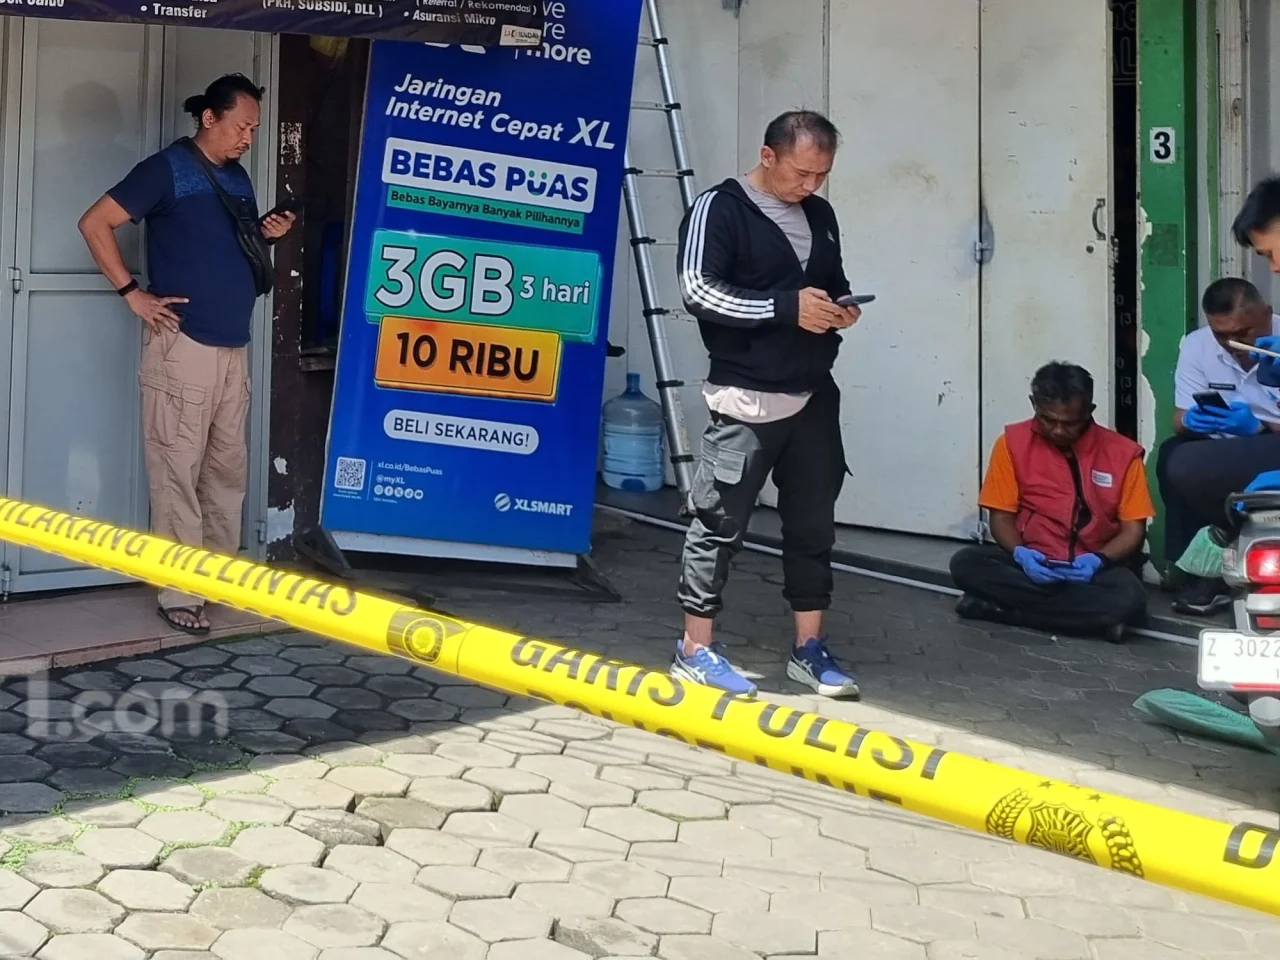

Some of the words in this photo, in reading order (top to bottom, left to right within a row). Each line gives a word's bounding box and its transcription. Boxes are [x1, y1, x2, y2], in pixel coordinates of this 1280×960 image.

[152, 3, 208, 19] Transfer
[412, 9, 461, 24] Asuransi
[464, 13, 496, 26] Mikro
[395, 74, 502, 107] Jaringan
[385, 96, 484, 130] Internet
[491, 113, 564, 141] Cepat
[569, 117, 615, 149] XL
[1153, 130, 1172, 160] 3
[390, 149, 496, 188] BEBAS
[391, 190, 425, 205] Bebas
[428, 196, 479, 214] Bayarnya
[483, 204, 522, 219] Banyak
[525, 210, 580, 228] Pilihannya
[374, 245, 514, 316] 3GB
[520, 275, 534, 300] 3
[542, 277, 590, 305] hari
[396, 332, 438, 369] 10
[449, 338, 540, 381] RIBU
[393, 418, 430, 435] BELI
[435, 423, 530, 448] SEKARANG!
[513, 498, 573, 517] XLSMART
[159, 539, 359, 617] MELINTAS
[510, 636, 688, 708] GARIS
[710, 688, 951, 781] POLISI
